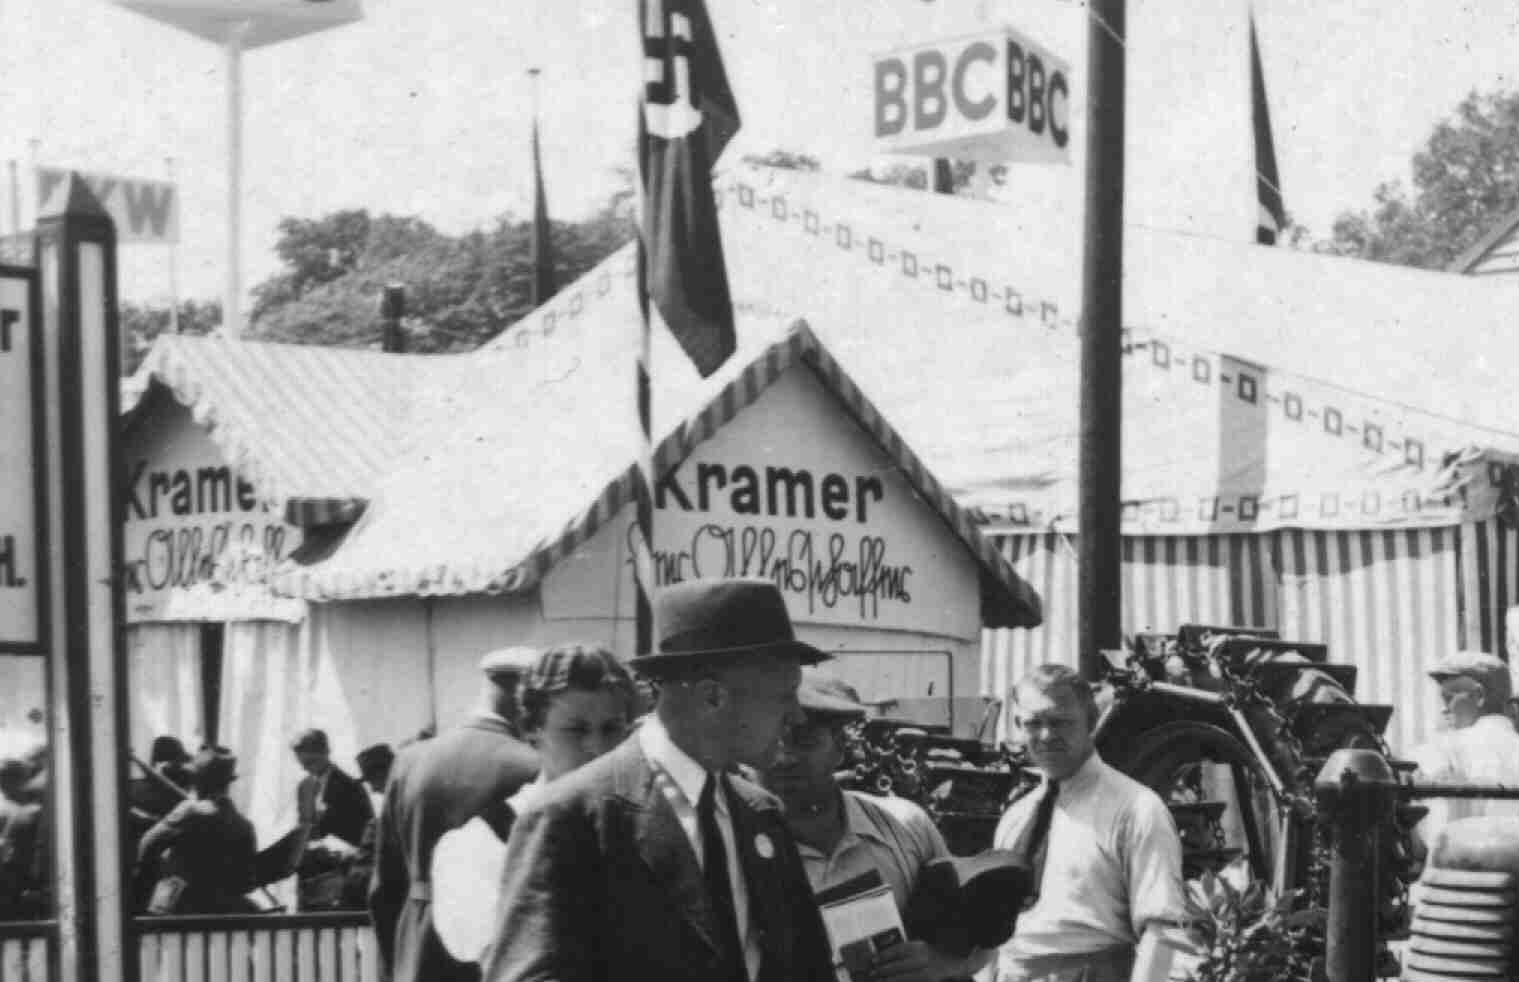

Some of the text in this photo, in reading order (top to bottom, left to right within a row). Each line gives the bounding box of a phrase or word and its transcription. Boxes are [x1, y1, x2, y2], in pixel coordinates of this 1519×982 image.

[875, 42, 998, 139] BBC
[1006, 38, 1070, 149] BBC
[128, 461, 270, 520] Krame
[654, 462, 884, 523] Kramer
